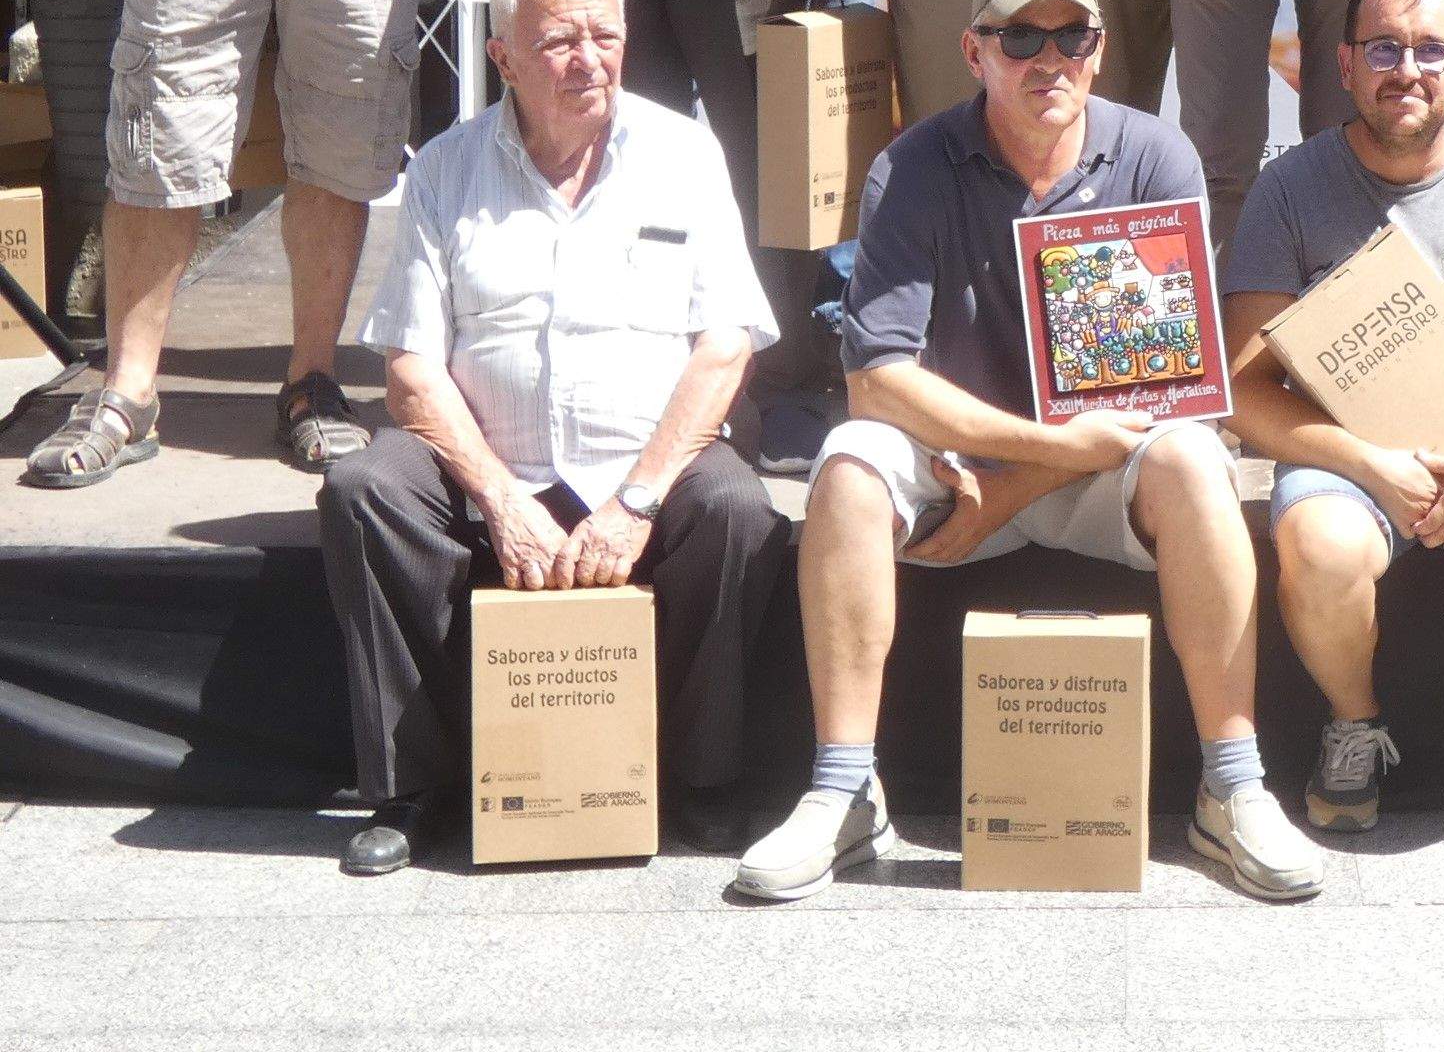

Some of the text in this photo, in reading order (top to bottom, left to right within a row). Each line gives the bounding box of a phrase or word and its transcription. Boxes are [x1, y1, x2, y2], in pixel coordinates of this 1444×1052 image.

[825, 84, 839, 99] los
[827, 102, 841, 118] del
[1043, 223, 1082, 242] Pieza
[1093, 218, 1120, 236] más
[1317, 282, 1426, 375] DESPENSA
[1335, 303, 1438, 392] DE BARBASTRO
[1074, 395, 1115, 413] Muestra
[487, 645, 638, 665] Saborea y disfruta
[508, 668, 618, 687] los productos
[977, 673, 1128, 693] Saborea y disfruta
[510, 689, 616, 709] del territorio
[997, 696, 1107, 715] los productos
[999, 717, 1104, 736] del territorio
[597, 790, 641, 800] GOBIERNO
[597, 799, 608, 808] DE
[1081, 821, 1126, 829] GOBIERNO
[1081, 828, 1092, 836] DE
